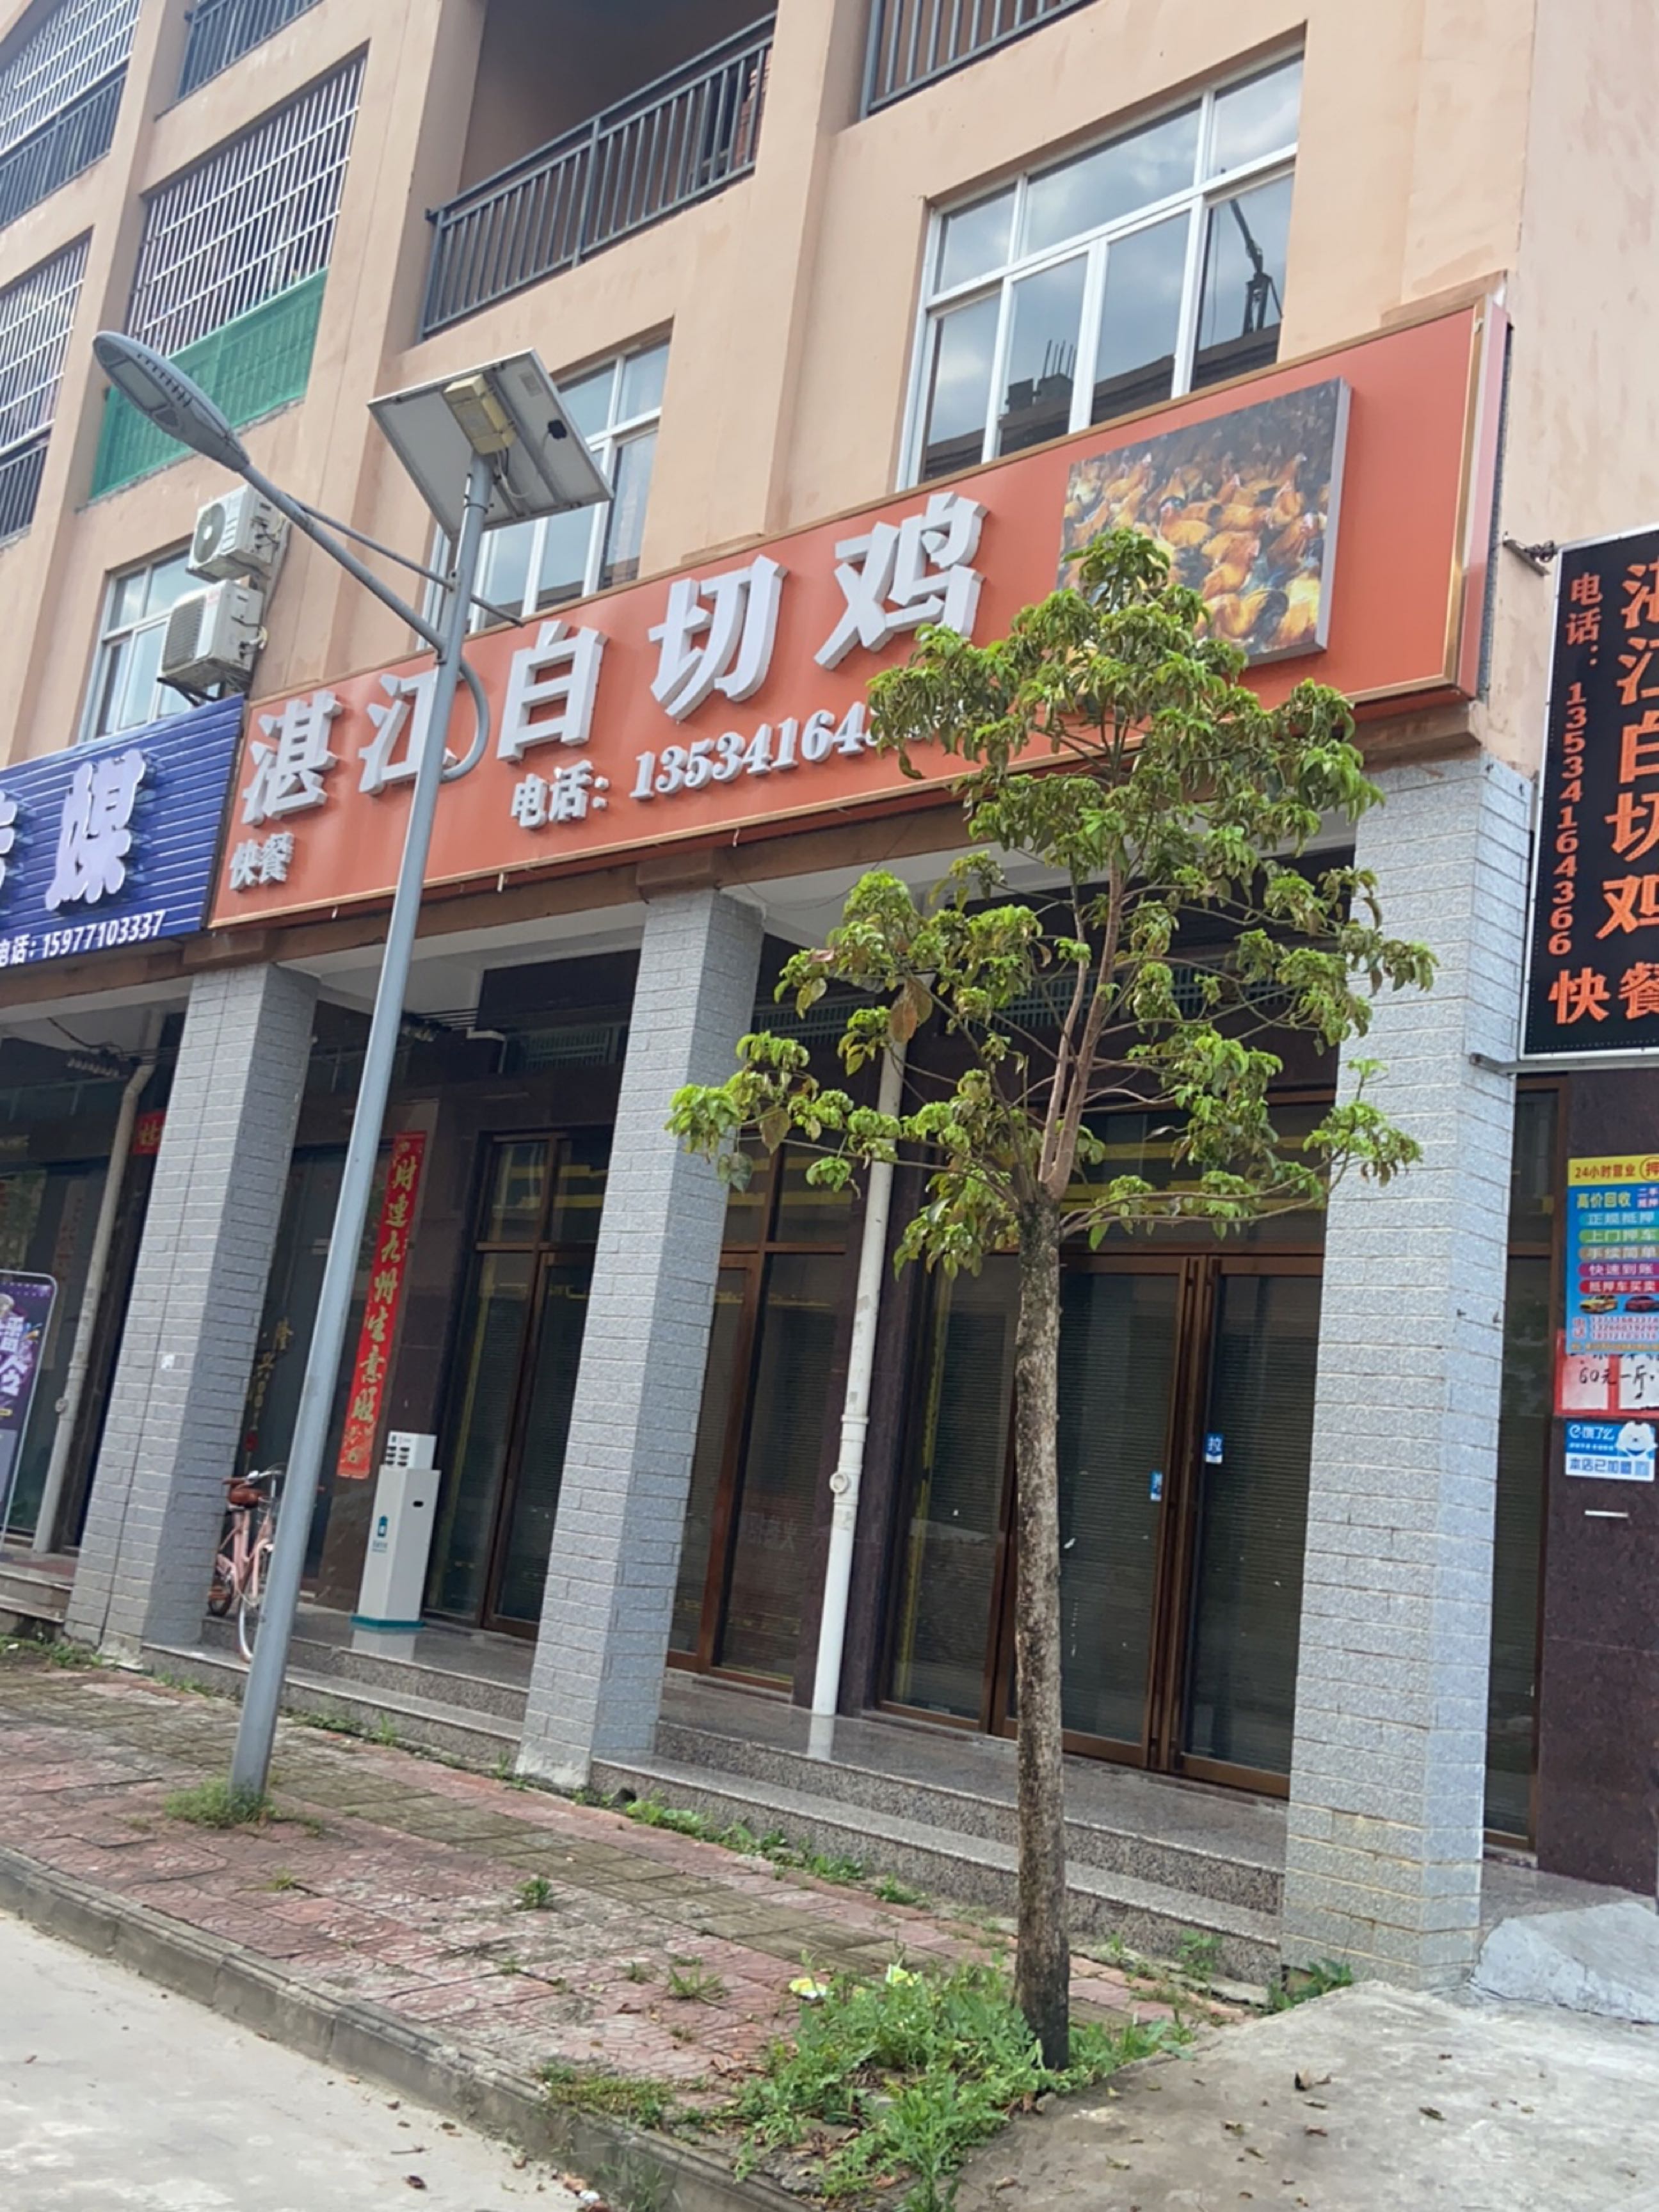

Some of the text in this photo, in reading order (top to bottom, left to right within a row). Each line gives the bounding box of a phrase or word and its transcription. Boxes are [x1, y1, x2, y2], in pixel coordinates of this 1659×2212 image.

[242, 492, 990, 825] 湛江白切鸡
[629, 694, 965, 801] 13534164
[1548, 682, 1589, 956] 13534164366
[229, 831, 295, 892] 快餐
[1575, 1164, 1636, 1179] 24小时营业
[1576, 1191, 1631, 1209] 高价回收
[1585, 1228, 1656, 1244] 上门押车
[1589, 1263, 1654, 1276] 快速到账
